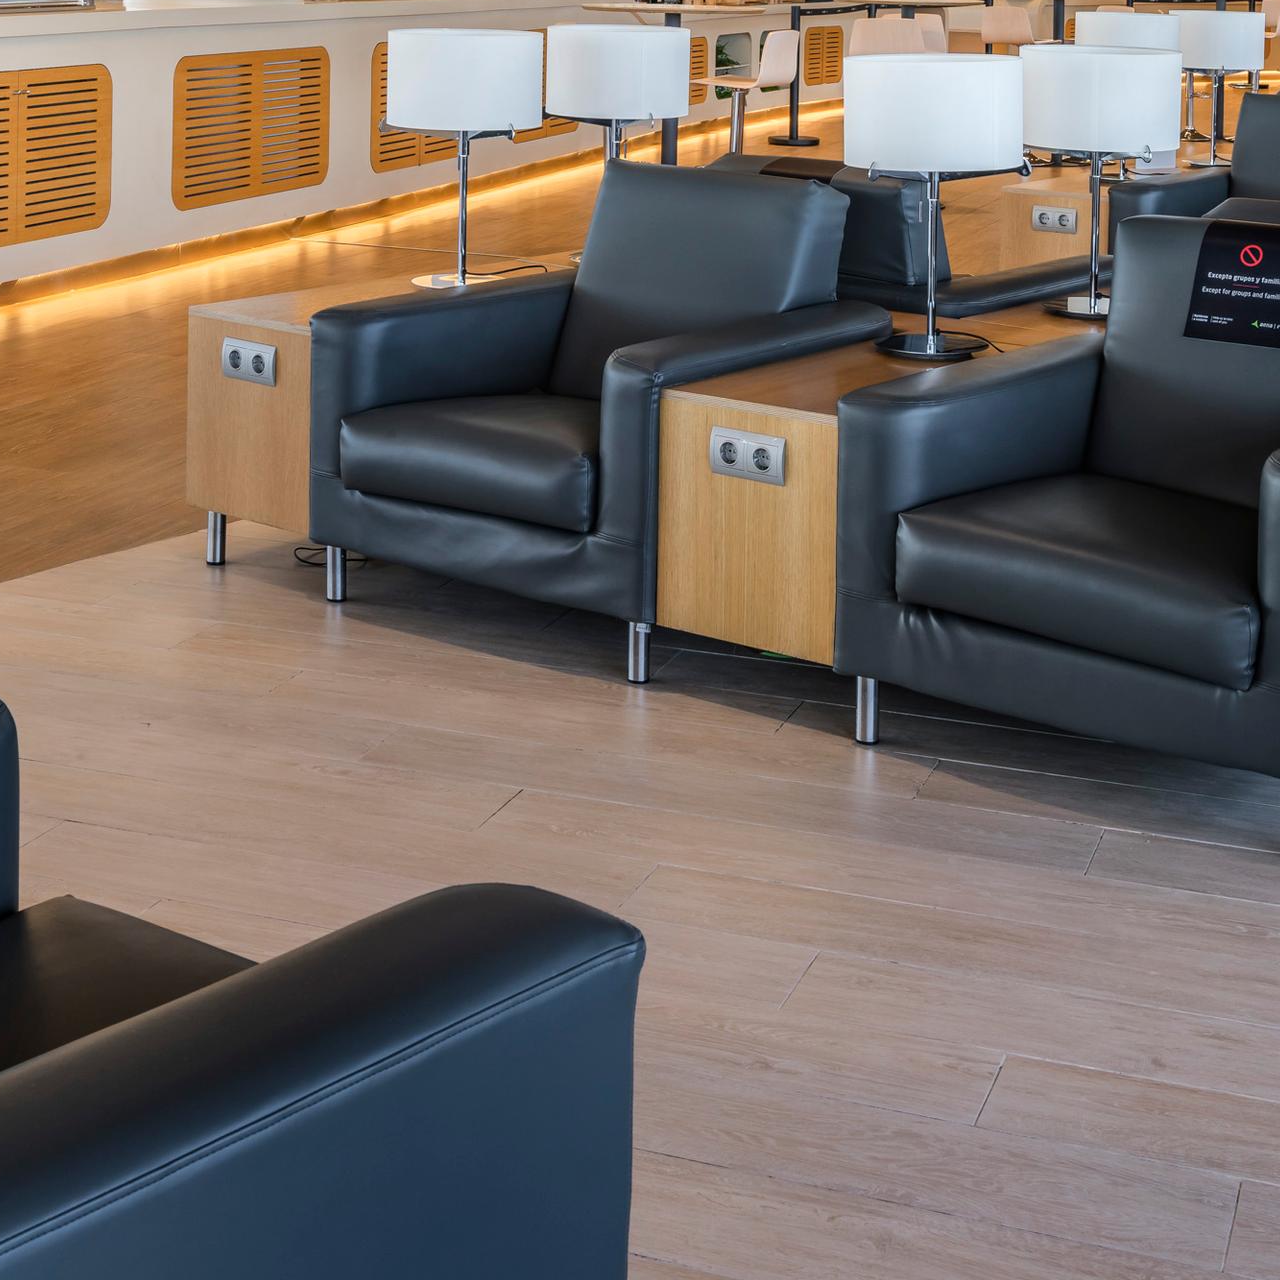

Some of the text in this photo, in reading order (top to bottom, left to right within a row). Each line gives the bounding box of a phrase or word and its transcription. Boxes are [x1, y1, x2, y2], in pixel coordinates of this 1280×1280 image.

[1207, 271, 1233, 280] Excepto
[1233, 275, 1255, 283] grupos
[1201, 285, 1221, 294] Except
[1231, 290, 1252, 298] groups
[1252, 291, 1264, 299] and
